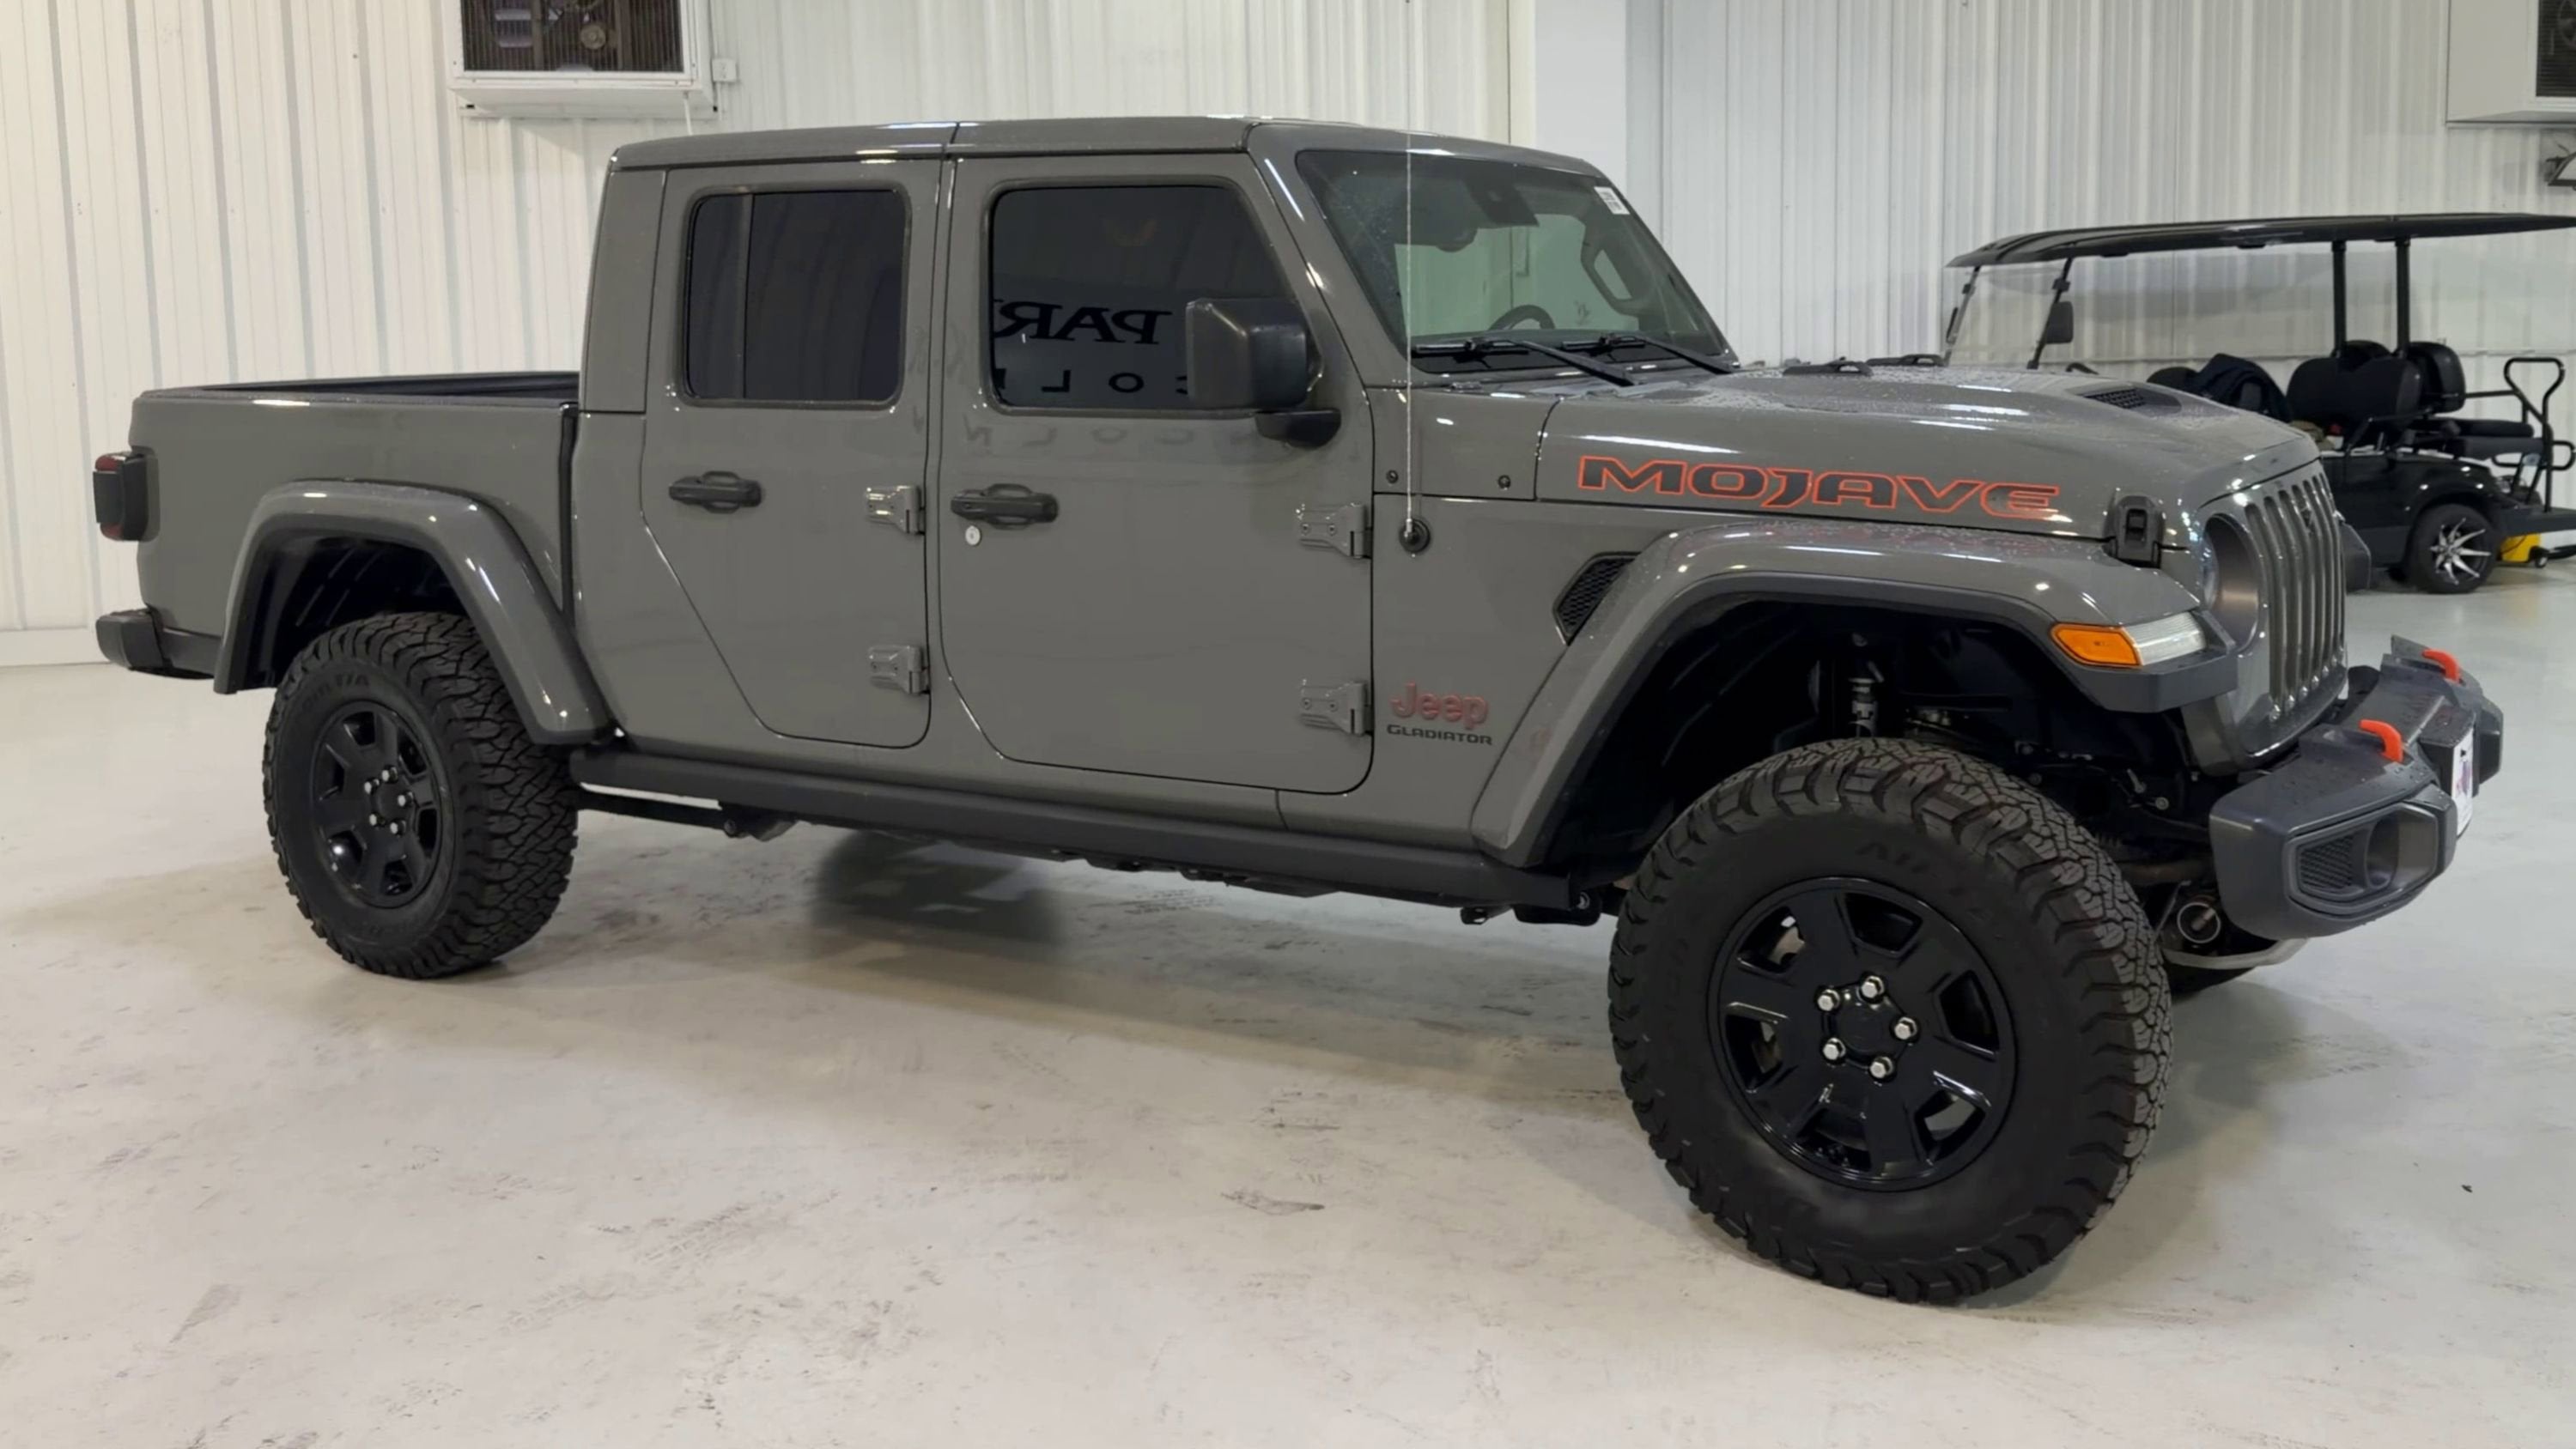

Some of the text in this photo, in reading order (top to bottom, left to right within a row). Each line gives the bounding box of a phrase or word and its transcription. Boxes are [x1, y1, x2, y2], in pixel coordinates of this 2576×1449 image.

[1578, 455, 2059, 518] MOJAVE
[1388, 680, 1489, 730] Jeep
[1387, 724, 1492, 745] GLADIATOR
